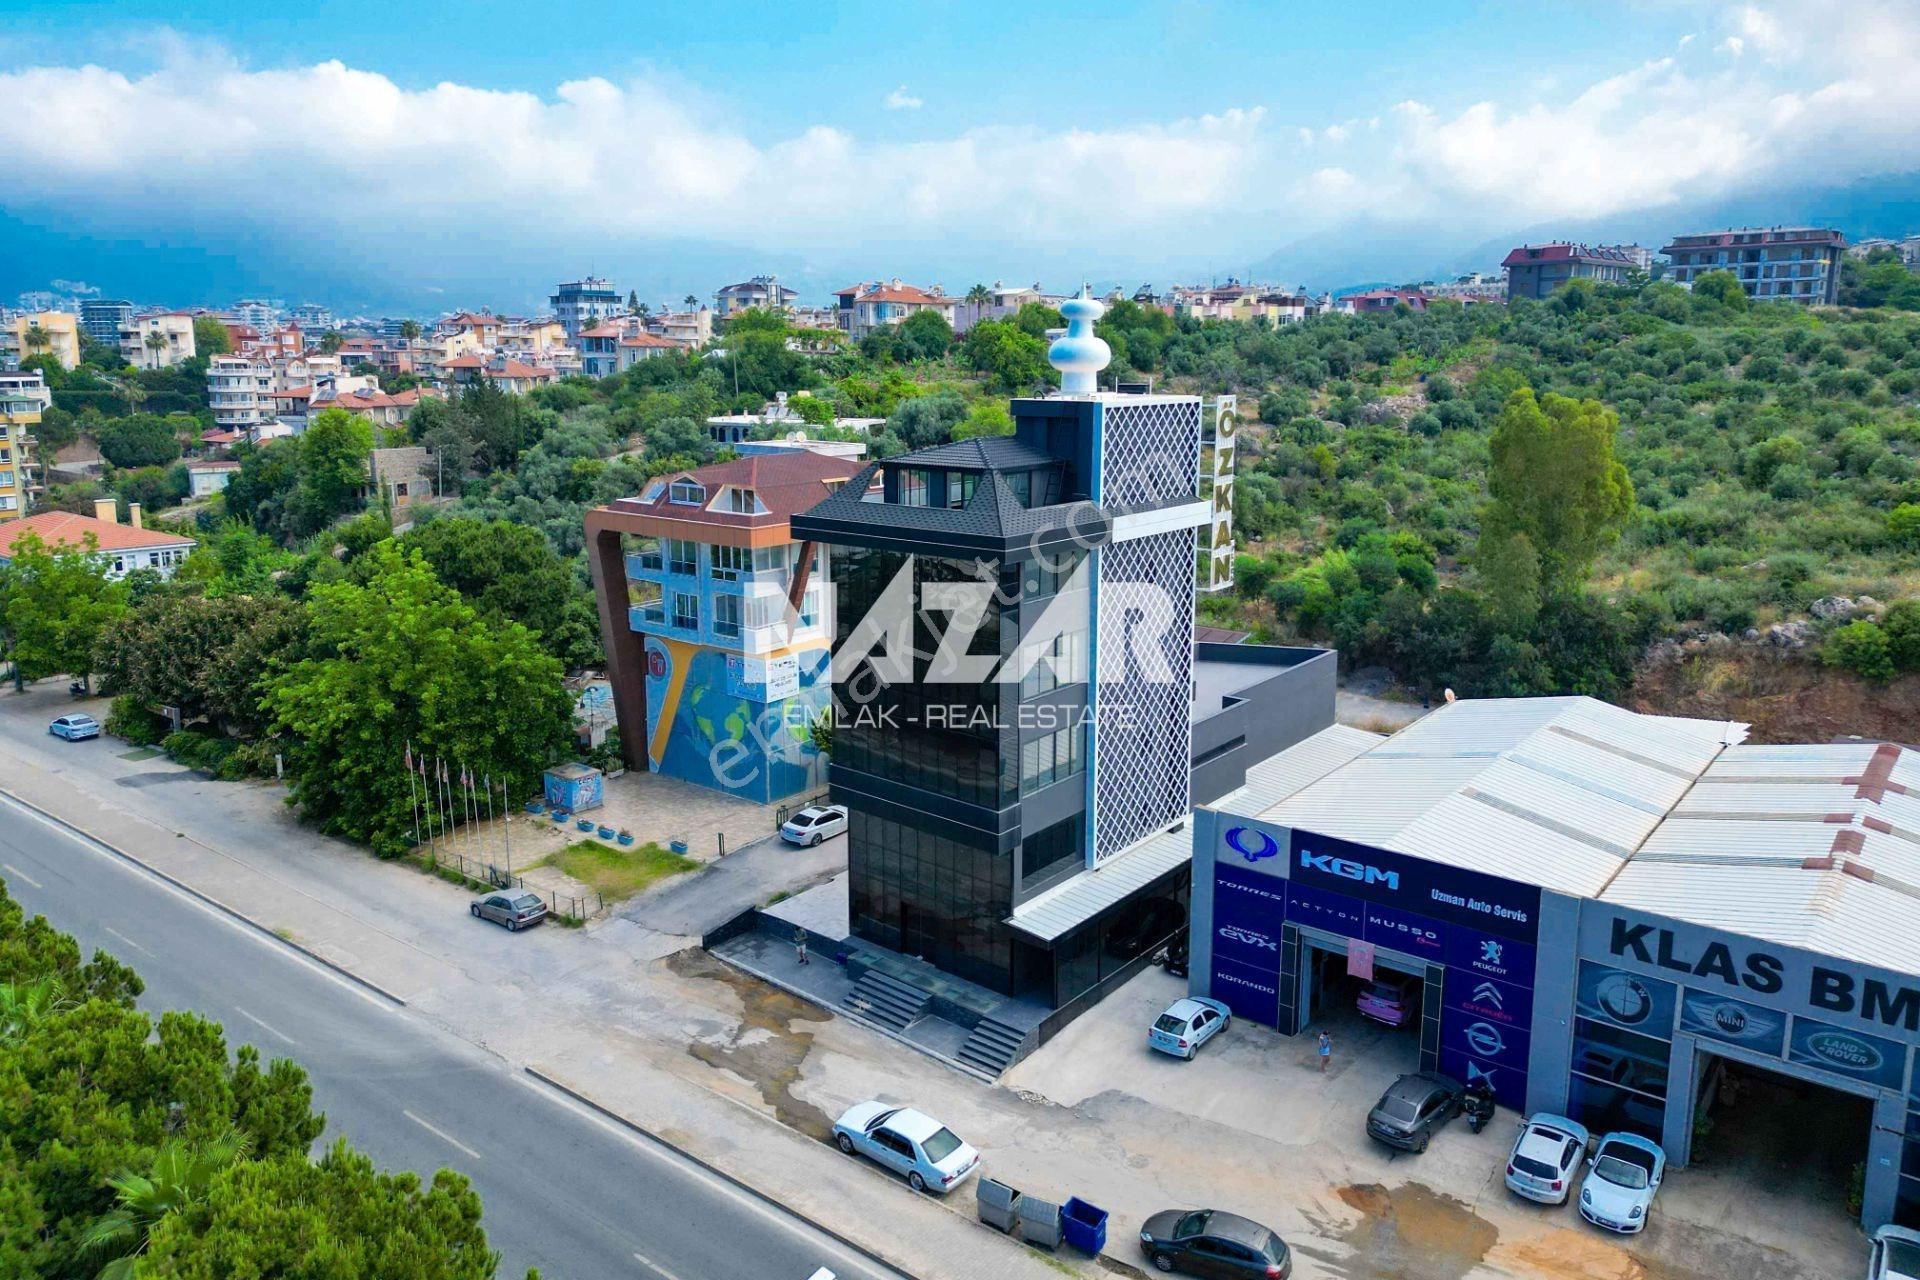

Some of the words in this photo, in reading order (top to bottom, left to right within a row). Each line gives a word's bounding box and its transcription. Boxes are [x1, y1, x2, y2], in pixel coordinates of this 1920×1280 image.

[1214, 402, 1235, 585] ÖZKAN
[1301, 850, 1399, 890] KGM
[1217, 879, 1282, 900] TORRES
[1290, 899, 1359, 922] ACTYON
[1431, 888, 1465, 907] Uzman
[1467, 898, 1492, 914] Auto
[1493, 905, 1528, 923] Servis
[1370, 916, 1437, 940] MUSSO
[1610, 917, 1785, 994] KLAS
[1472, 961, 1508, 975] PEUGEOT
[1217, 972, 1275, 994] KORANDO
[1717, 1013, 1745, 1028] MINI
[1823, 1038, 1859, 1053] LAND
[1825, 1047, 1869, 1064] ROVER
